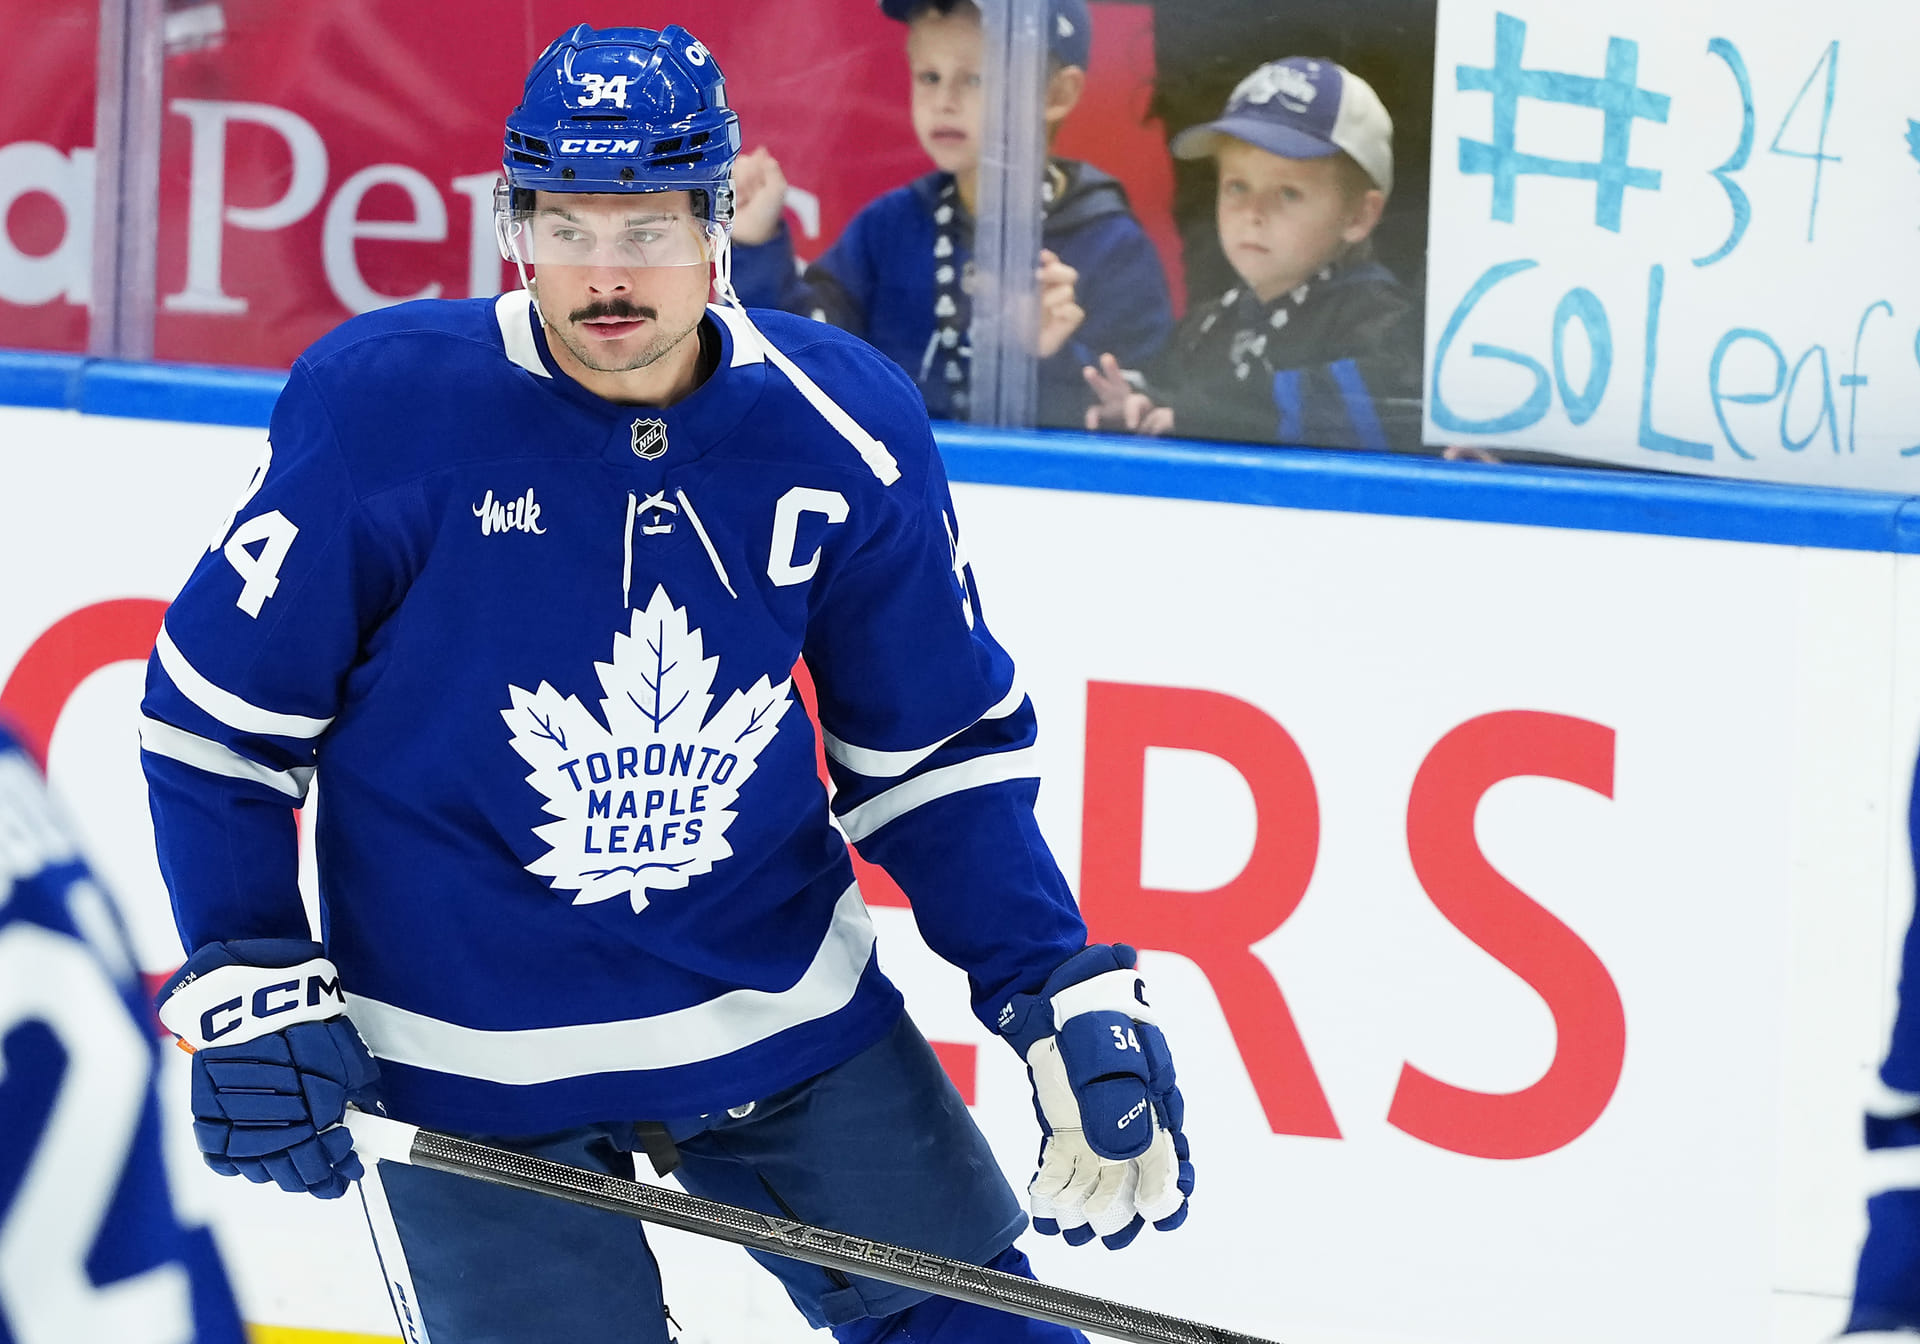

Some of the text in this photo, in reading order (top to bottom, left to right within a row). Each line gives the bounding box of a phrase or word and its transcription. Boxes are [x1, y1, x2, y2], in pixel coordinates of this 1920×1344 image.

[576, 73, 629, 108] 34
[558, 138, 641, 155] CCM
[639, 429, 660, 451] NHL
[472, 488, 547, 536] Milk
[767, 486, 850, 587] C
[557, 743, 738, 792] TORONTO
[588, 784, 709, 819] MAPLE
[584, 818, 703, 854] LEAFS
[200, 975, 347, 1043] CCM
[1110, 1025, 1141, 1053] 34
[1117, 1098, 1148, 1130] CCM
